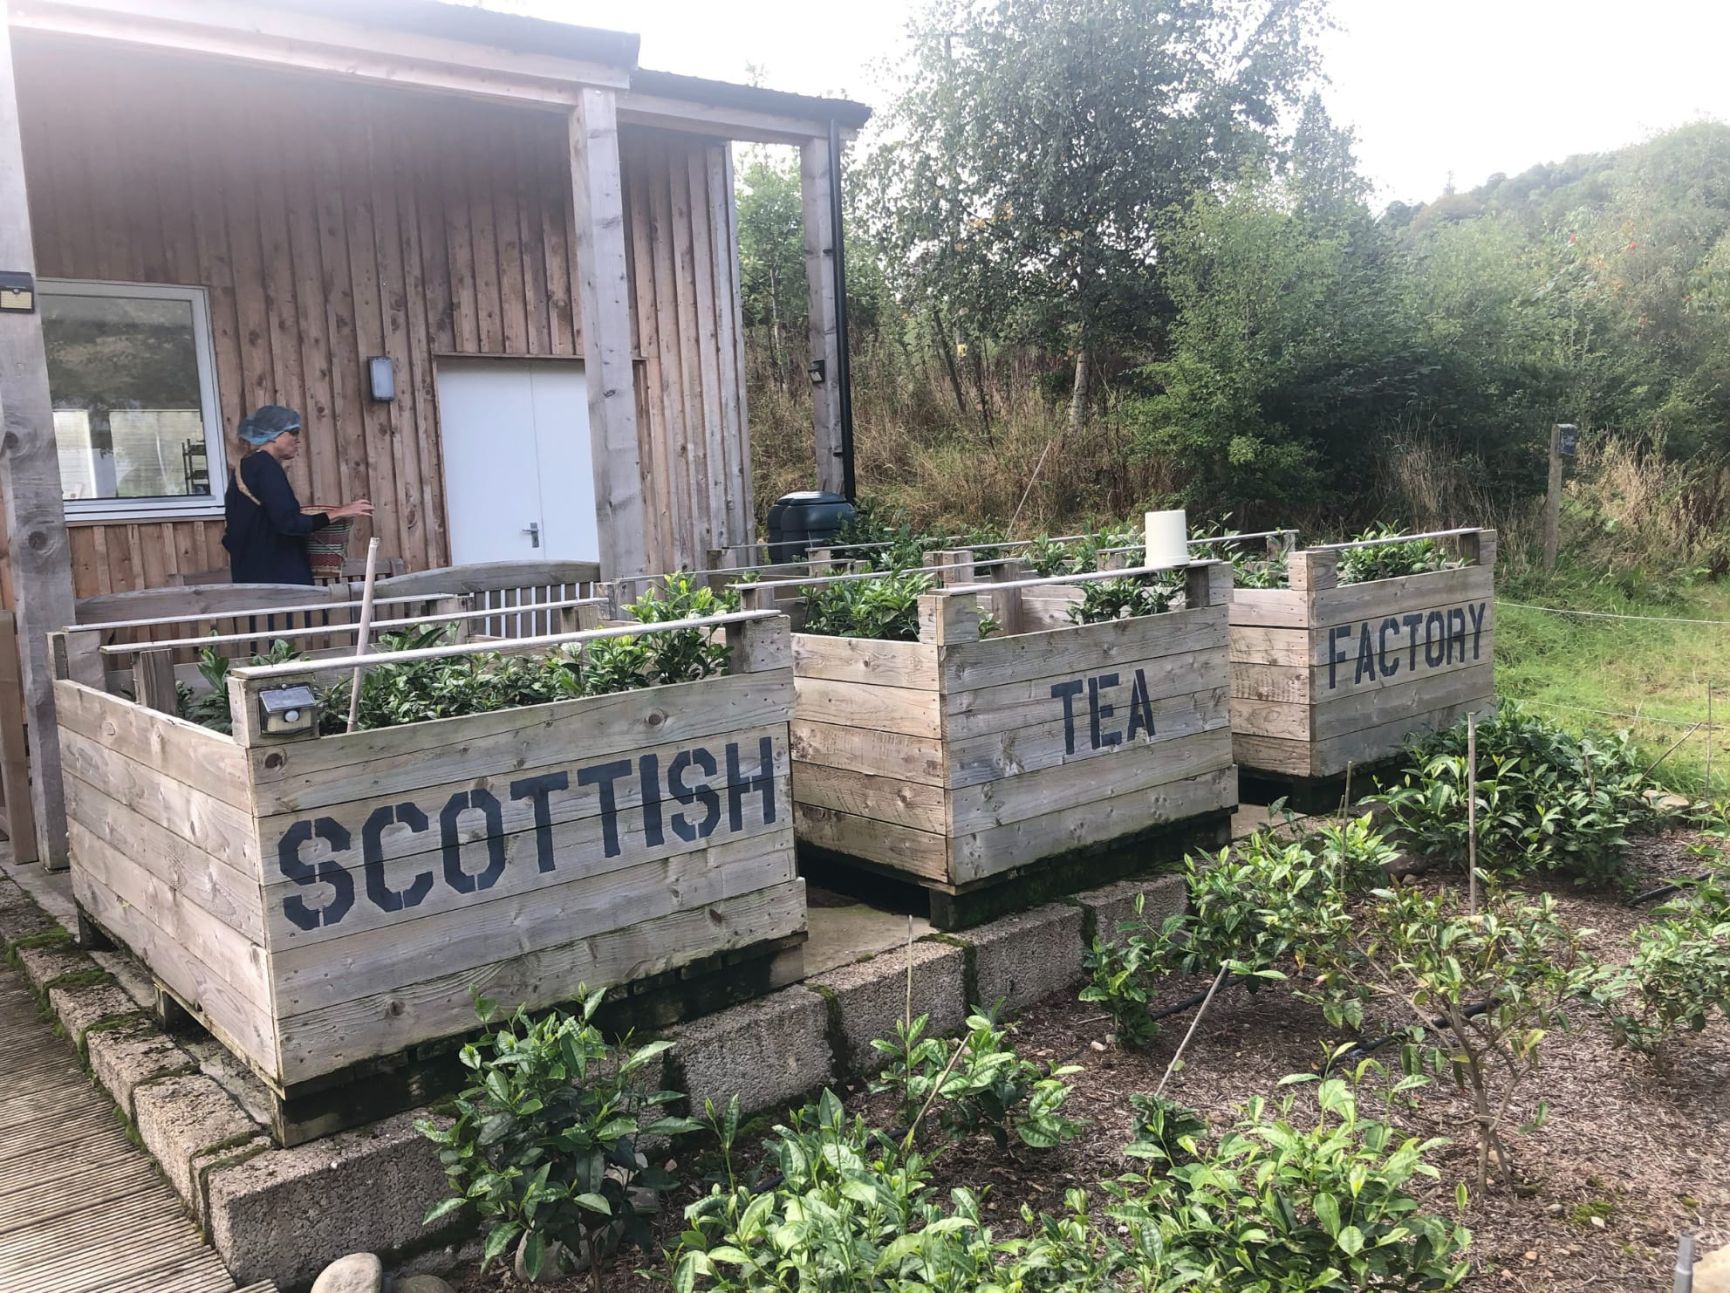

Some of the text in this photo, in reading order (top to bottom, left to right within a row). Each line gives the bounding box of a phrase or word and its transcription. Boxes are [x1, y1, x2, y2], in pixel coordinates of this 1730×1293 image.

[1328, 602, 1486, 689] FACTORY
[1051, 668, 1156, 755] TEA
[277, 736, 776, 931] SCOTTISH
